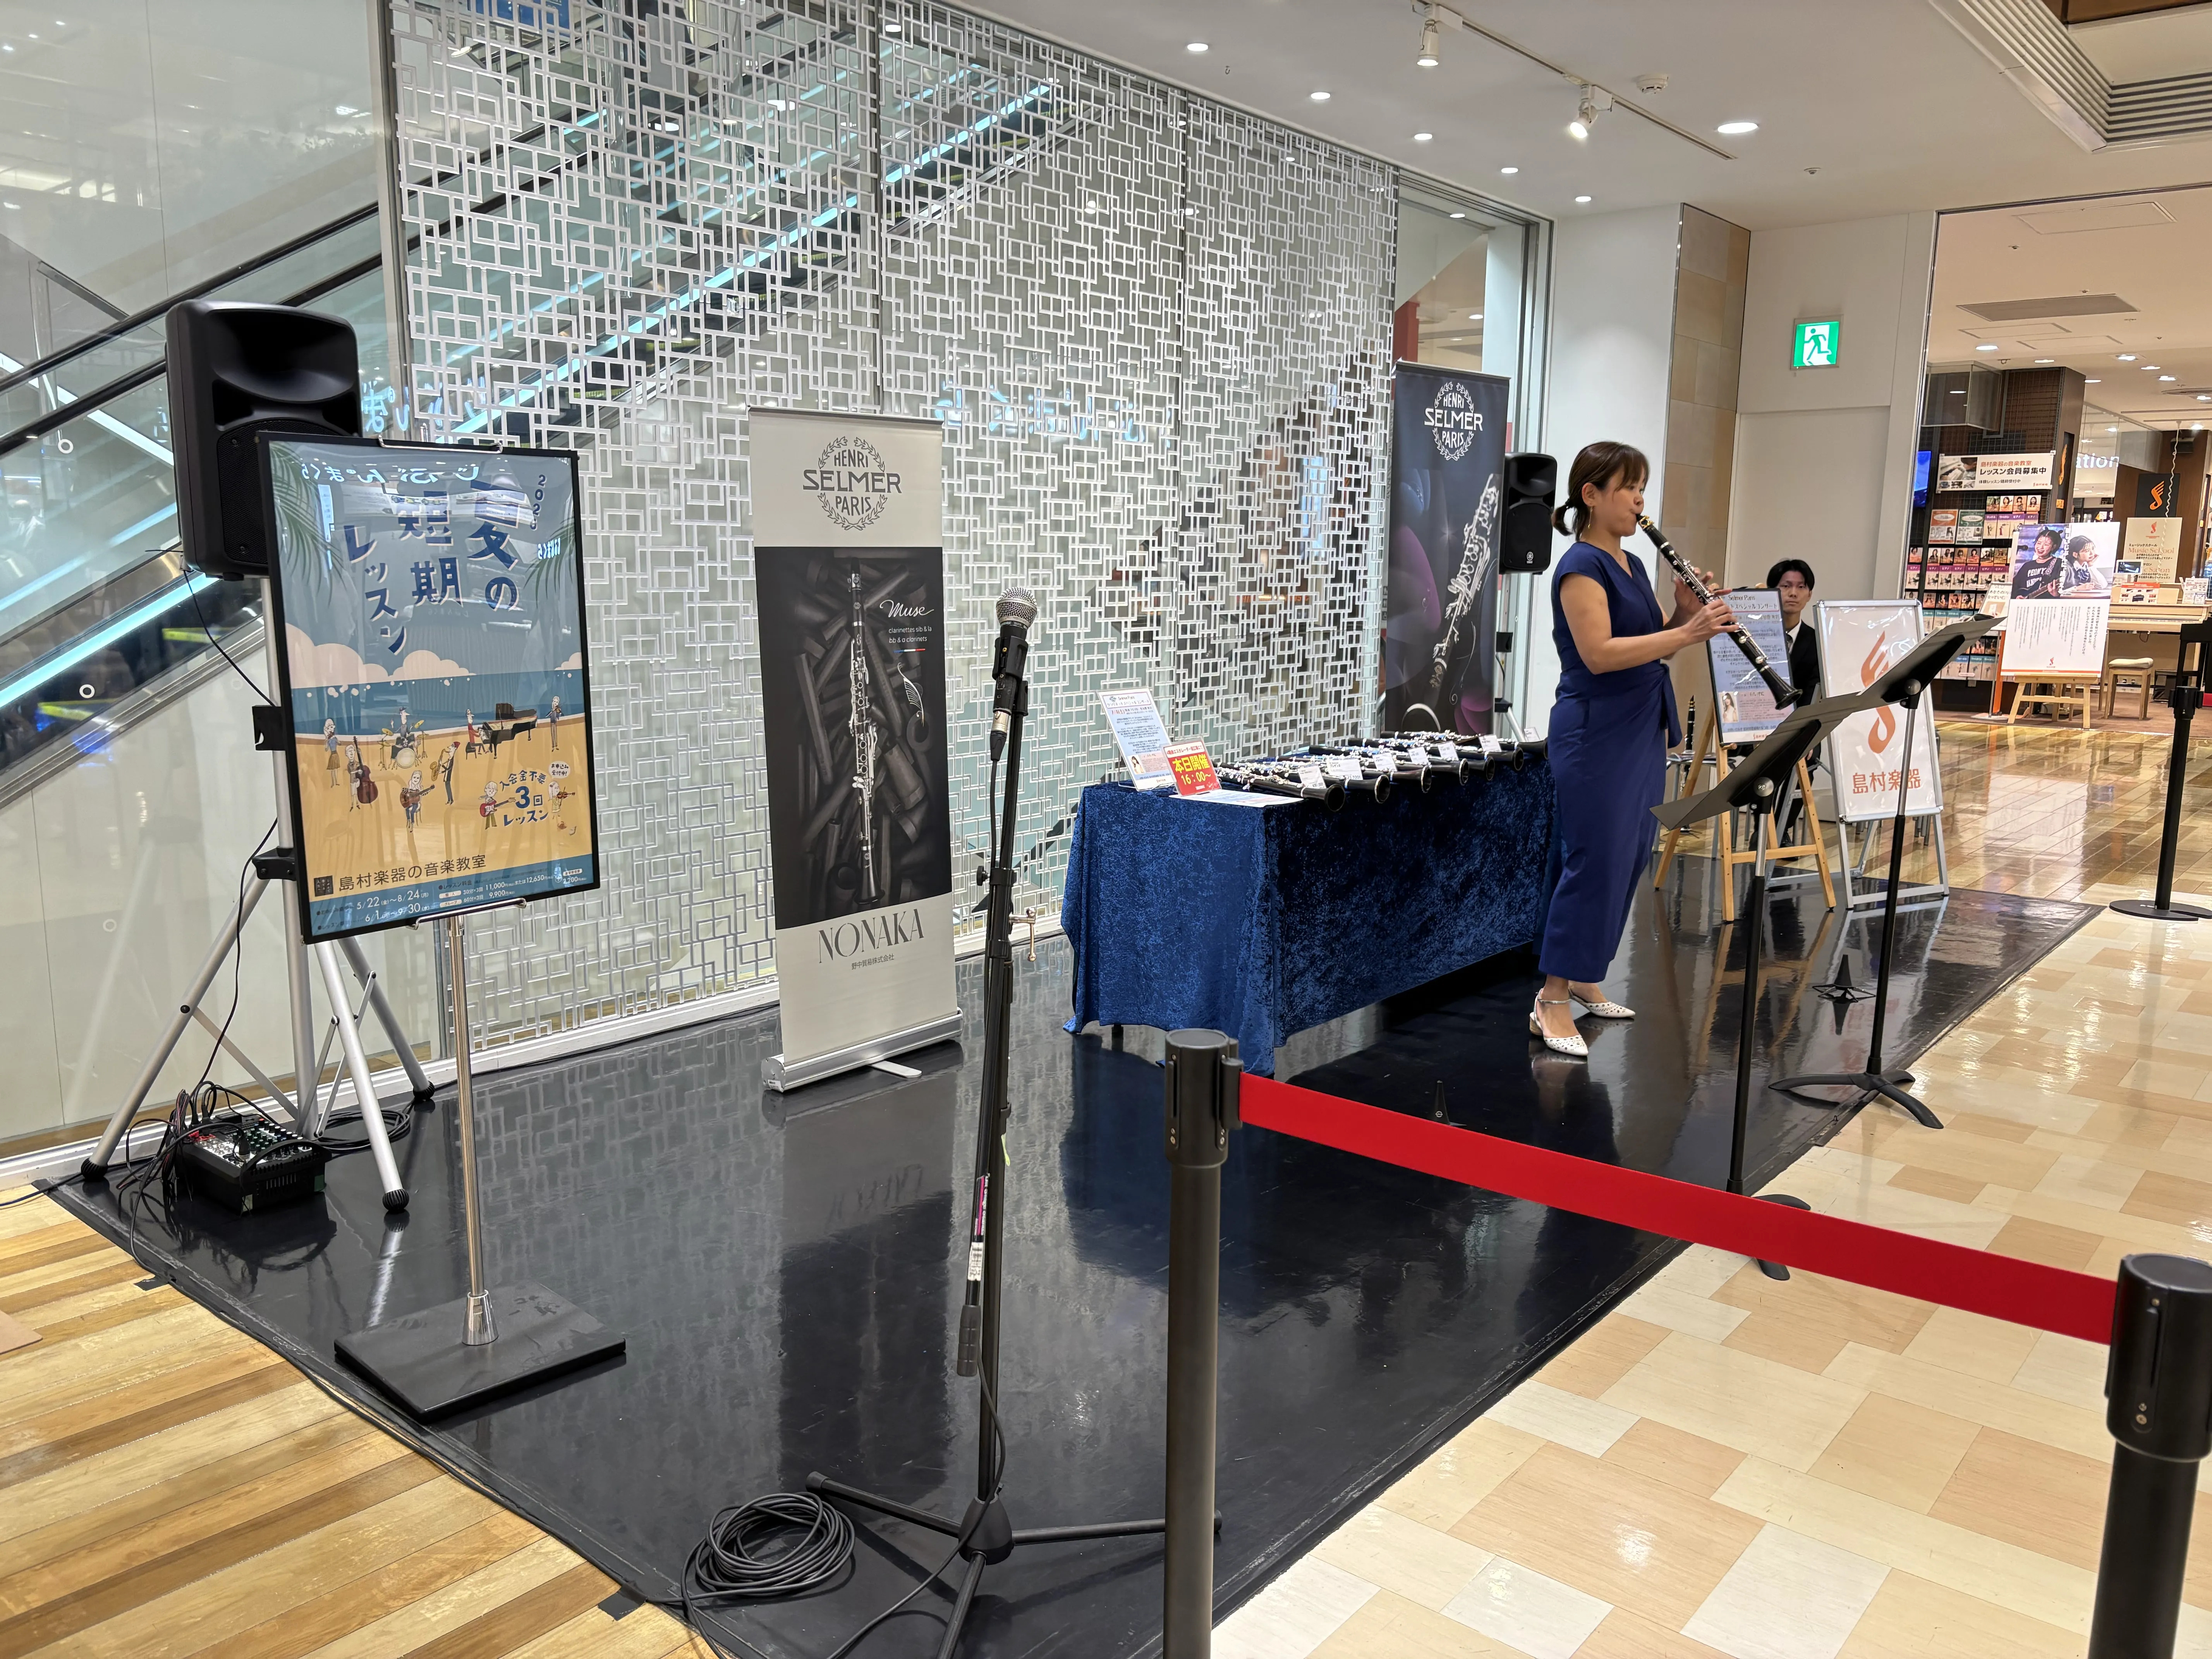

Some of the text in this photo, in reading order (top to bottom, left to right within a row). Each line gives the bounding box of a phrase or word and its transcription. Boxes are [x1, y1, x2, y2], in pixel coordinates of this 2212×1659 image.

[1443, 392, 1465, 409] HENRI
[1424, 407, 1483, 431] SELMER
[1442, 430, 1464, 449] PARIS
[834, 448, 869, 468] HENRI
[802, 469, 902, 494] SELMER
[1980, 467, 2047, 476] レッスン会員募集中
[835, 496, 872, 517] PARIS
[397, 491, 464, 608] 短期
[343, 525, 407, 656] レッスン
[879, 599, 934, 618] Muse
[1172, 753, 1211, 774] 本日開催
[499, 769, 547, 792] 入会金不要
[1852, 768, 1921, 794] 島村楽器
[515, 785, 543, 809] 3回
[503, 810, 549, 827] レッスン
[339, 854, 487, 892] 島村楽器の音楽教室
[818, 908, 924, 963] NONAKA
[851, 953, 895, 970] 野中貿易株式会社
